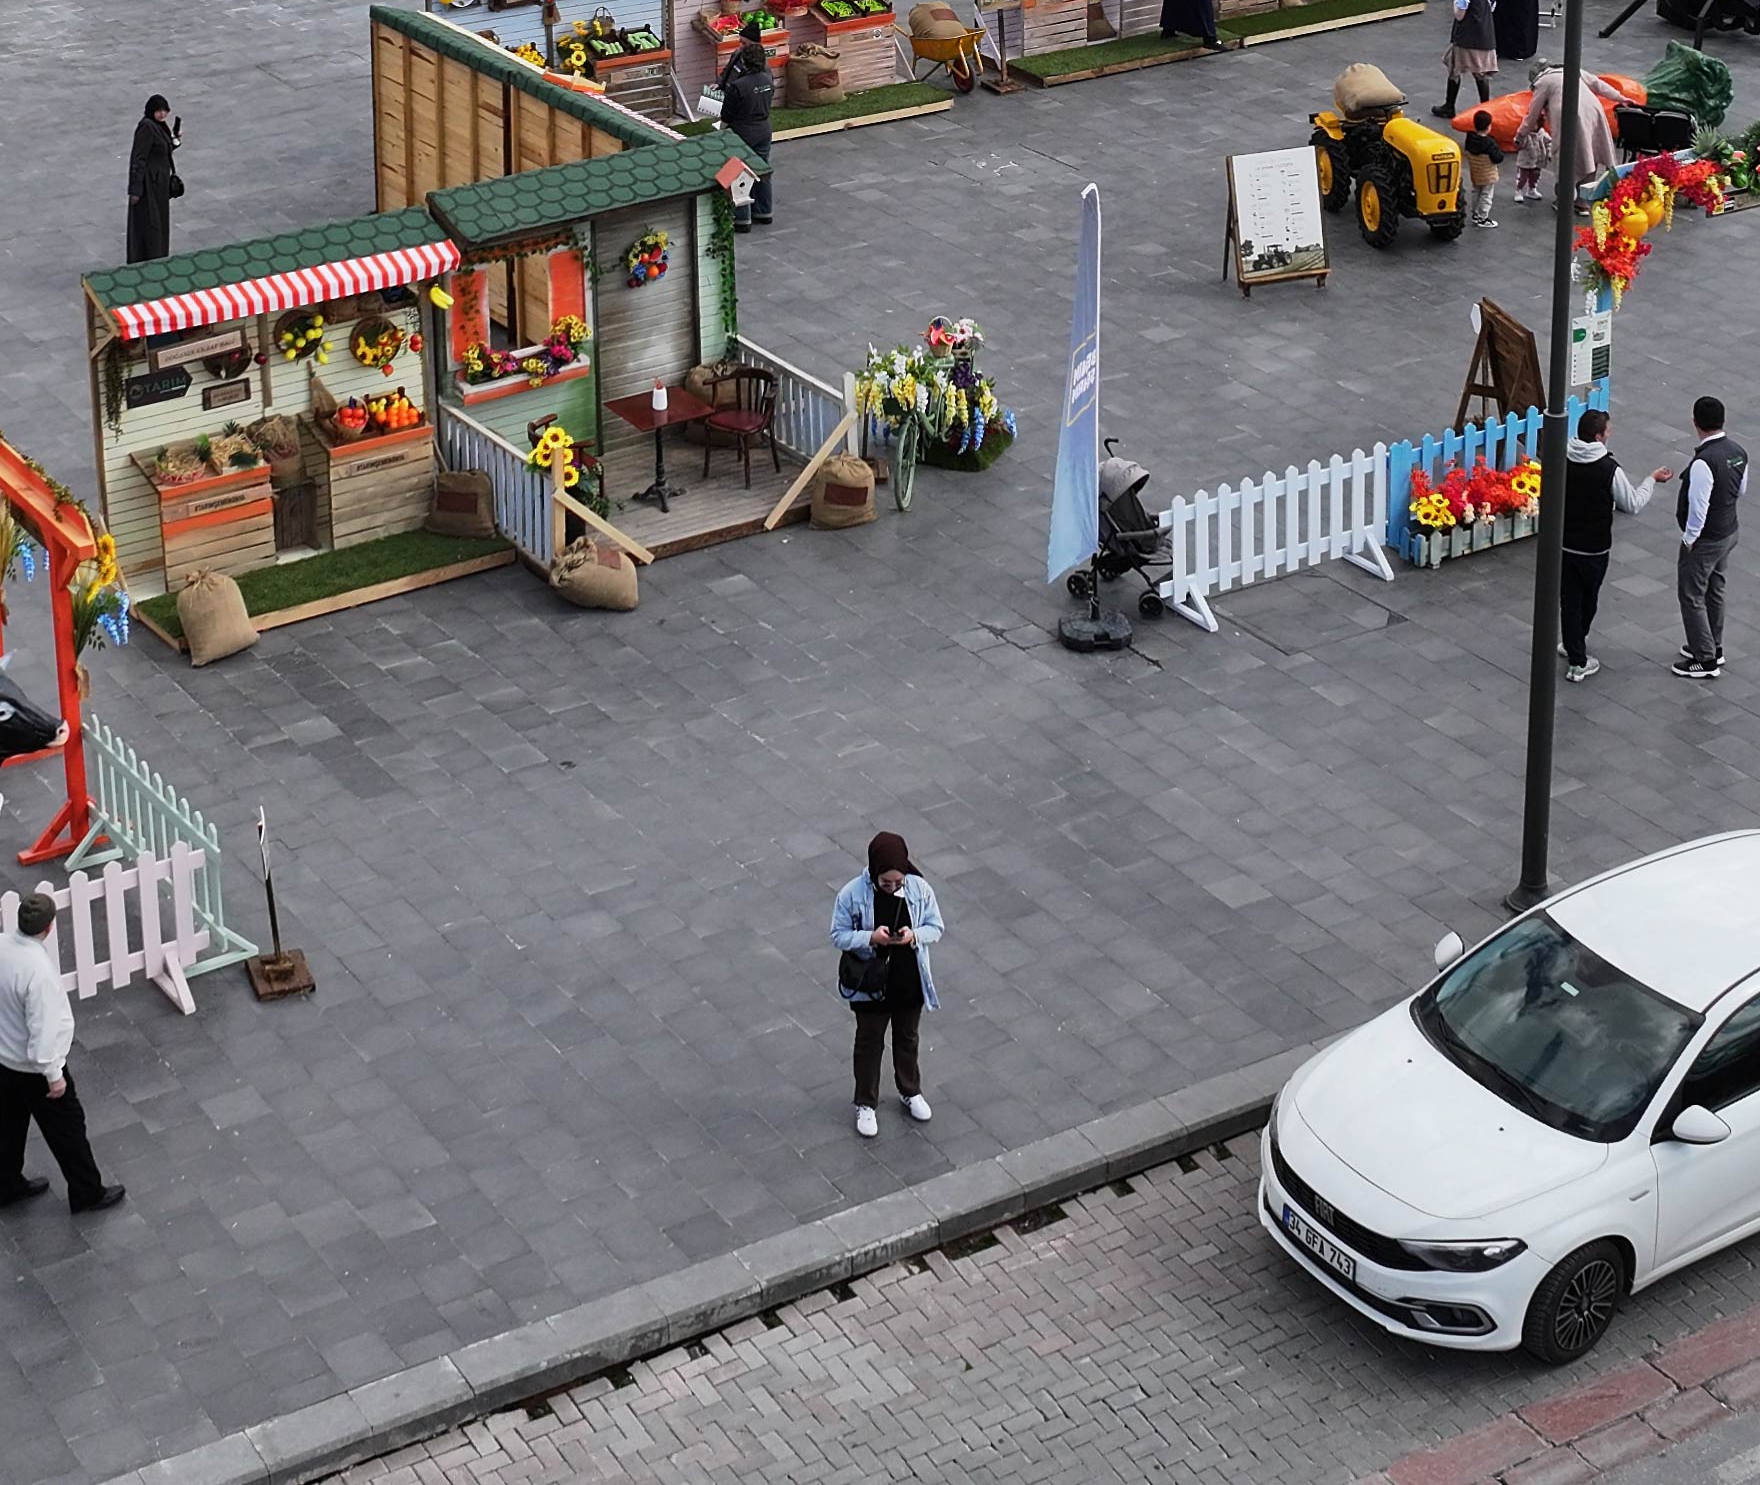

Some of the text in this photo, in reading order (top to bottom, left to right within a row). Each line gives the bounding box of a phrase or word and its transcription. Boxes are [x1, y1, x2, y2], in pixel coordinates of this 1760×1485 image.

[144, 376, 186, 392] TARIM
[1314, 1195, 1335, 1226] FIAT
[1289, 1213, 1351, 1275] 34 GFA 743
